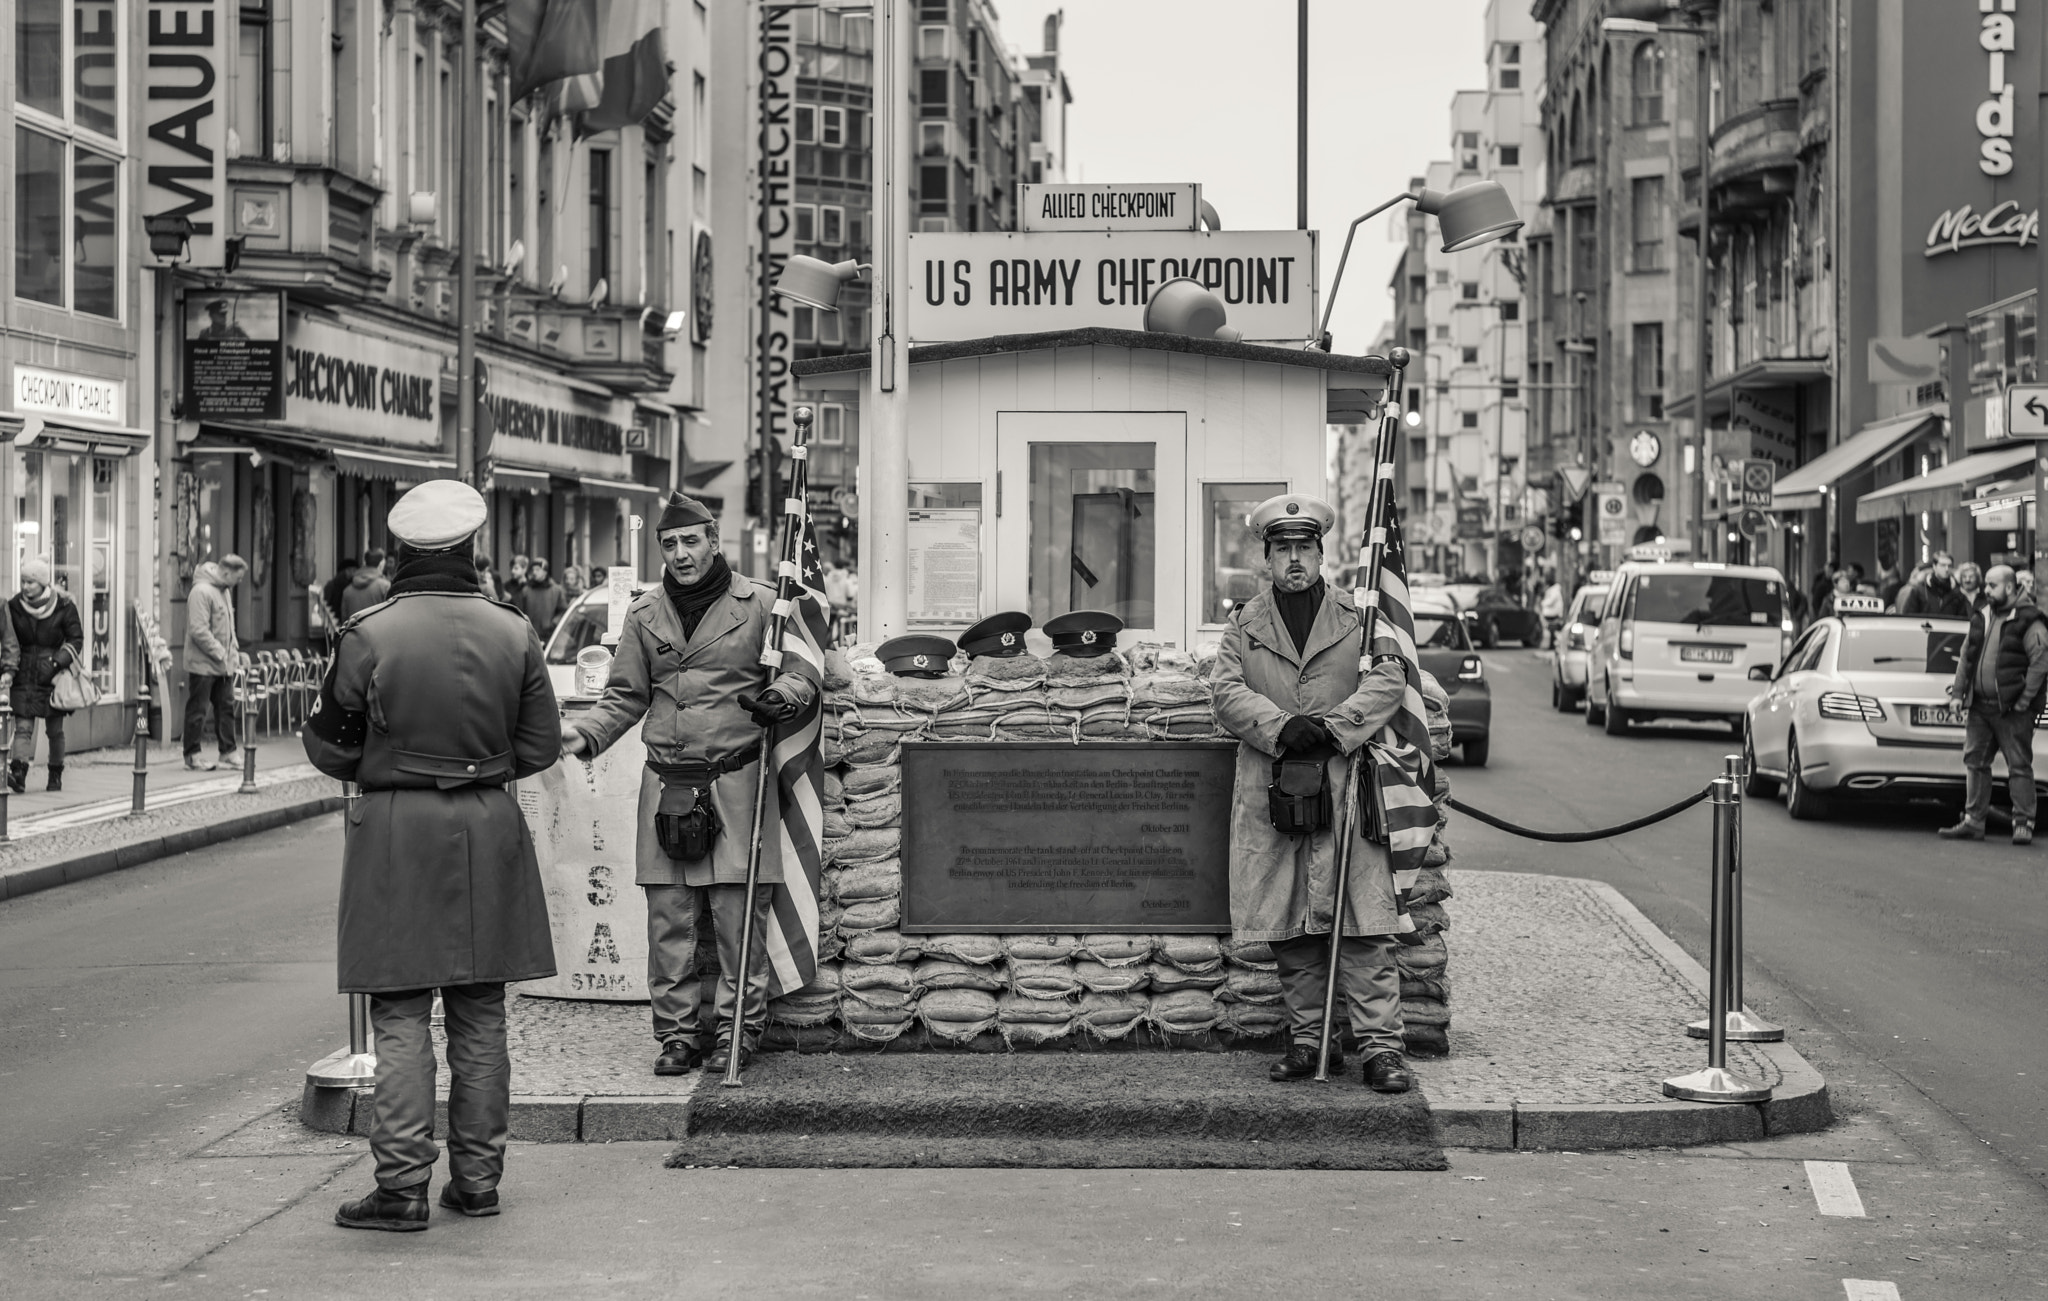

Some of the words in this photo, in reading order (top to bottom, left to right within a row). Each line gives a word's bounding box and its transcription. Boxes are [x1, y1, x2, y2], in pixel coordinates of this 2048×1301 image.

[1976, 0, 2016, 176] alds
[148, 0, 214, 236] MAUE
[757, 2, 790, 239] CHECKPOIN
[1041, 192, 1086, 219] ALLIED
[1092, 191, 1177, 219] CHECKPOINT
[925, 258, 971, 307] US
[989, 258, 1081, 307] ARMY
[21, 375, 75, 409] CHECKPOINT
[78, 384, 111, 415] CHARLIE
[286, 344, 378, 412] CHECKPOINT
[381, 367, 433, 422] CHARLIE
[1737, 392, 1795, 424] Pizza
[1752, 449, 1793, 470] alat
[1744, 491, 1771, 505] TAXI
[1844, 599, 1875, 609] TAXI
[1112, 769, 1154, 779] Checkpoint
[1155, 769, 1183, 778] Charlie
[1141, 824, 1172, 833] Oktober
[1173, 824, 1190, 833] 2011
[1005, 869, 1017, 878] US
[1141, 899, 1171, 909] October
